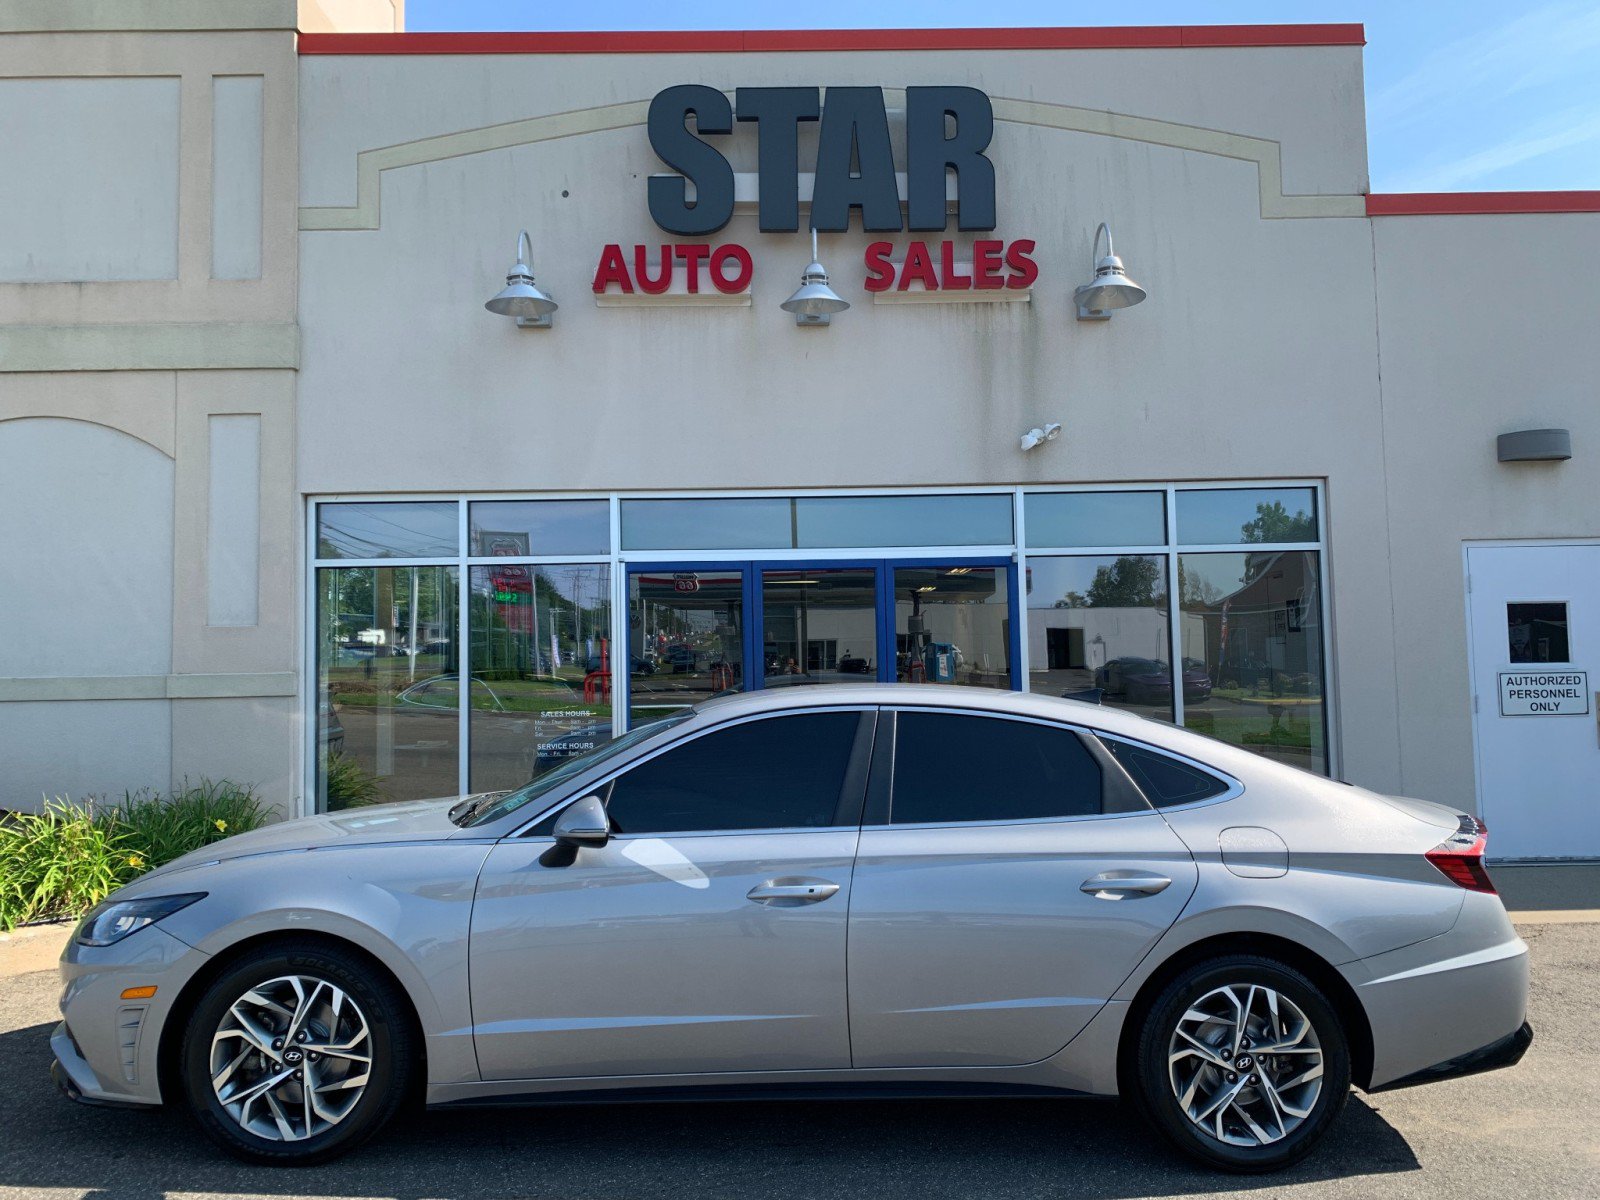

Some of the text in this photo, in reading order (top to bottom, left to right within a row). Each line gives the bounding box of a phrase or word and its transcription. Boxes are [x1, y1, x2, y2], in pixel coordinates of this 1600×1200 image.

[647, 84, 996, 236] STAR
[592, 239, 1039, 294] AUTO SALES
[1506, 675, 1581, 686] AUTHORIZED
[1509, 688, 1581, 699] PERSONNEL
[1530, 702, 1561, 712] ONLY
